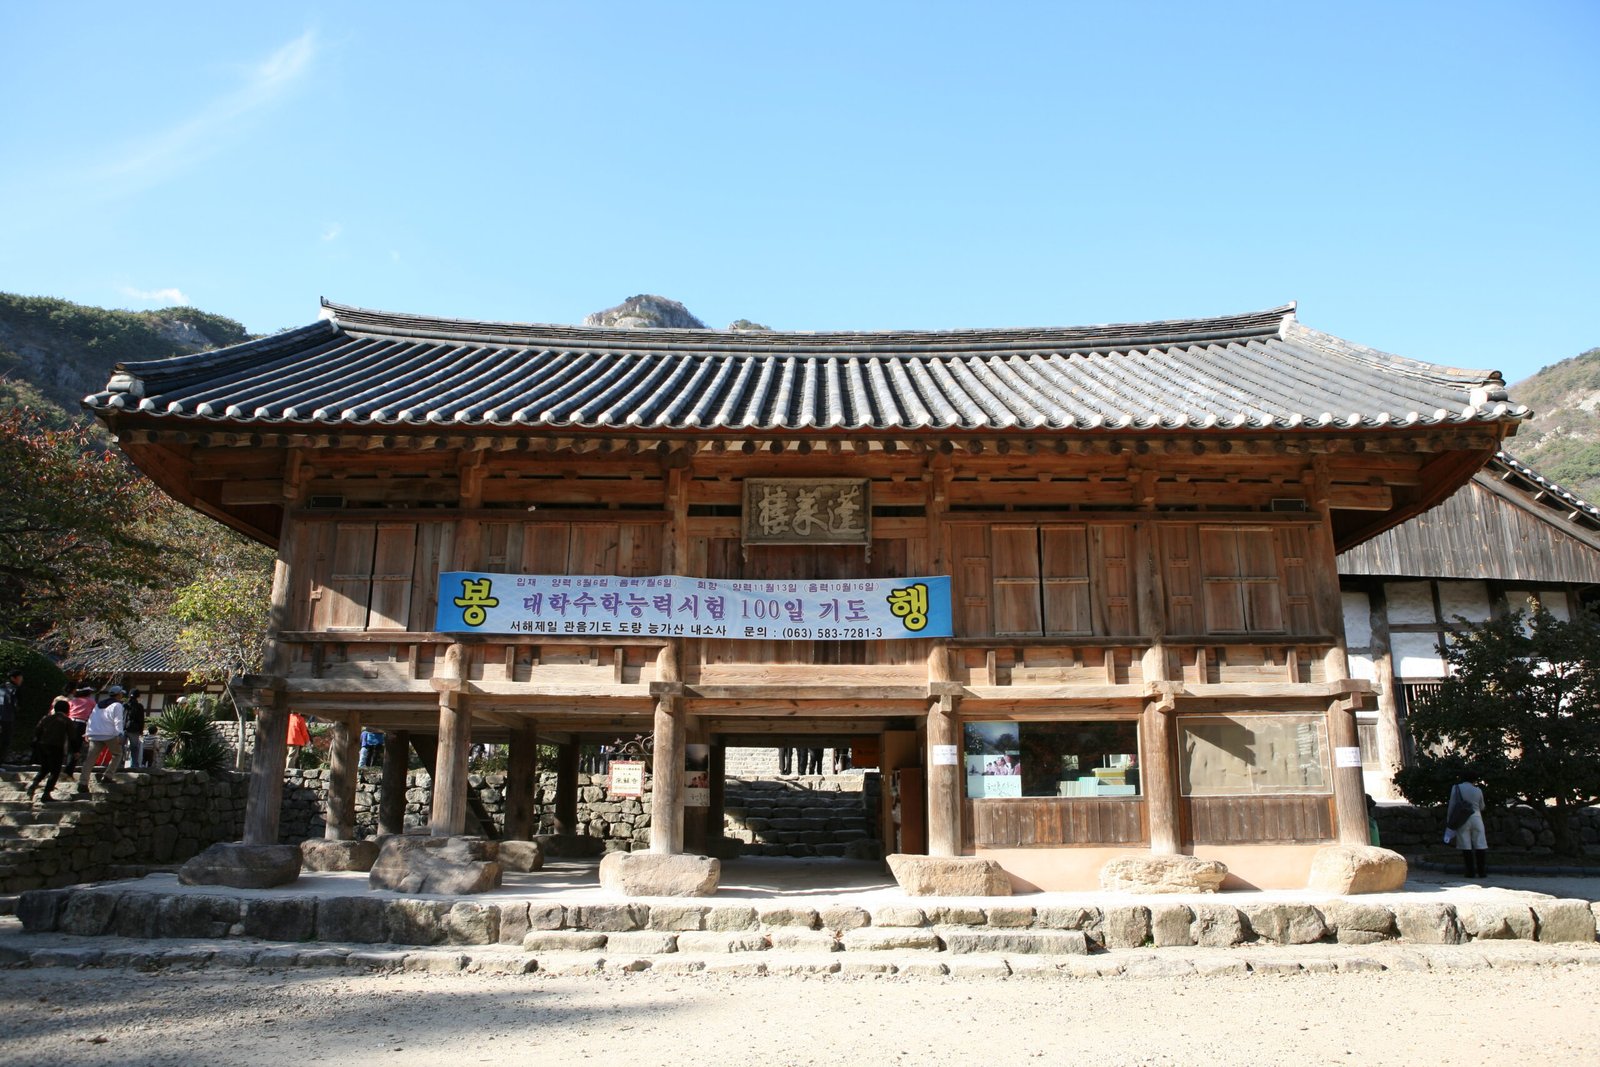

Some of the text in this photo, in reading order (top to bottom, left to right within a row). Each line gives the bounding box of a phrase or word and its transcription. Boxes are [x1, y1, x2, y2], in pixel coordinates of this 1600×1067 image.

[551, 578, 572, 588] 양력
[697, 580, 718, 591] 회향
[454, 577, 500, 627] 봉
[523, 591, 870, 623] 대학수학능력시험 100일 기도
[886, 583, 929, 632] 행
[510, 621, 727, 636] 서해제일 관음기도 도량 능가산 내소사
[744, 626, 767, 638] 문의
[782, 628, 813, 639] (063)
[817, 627, 883, 638] 583-7281-3
